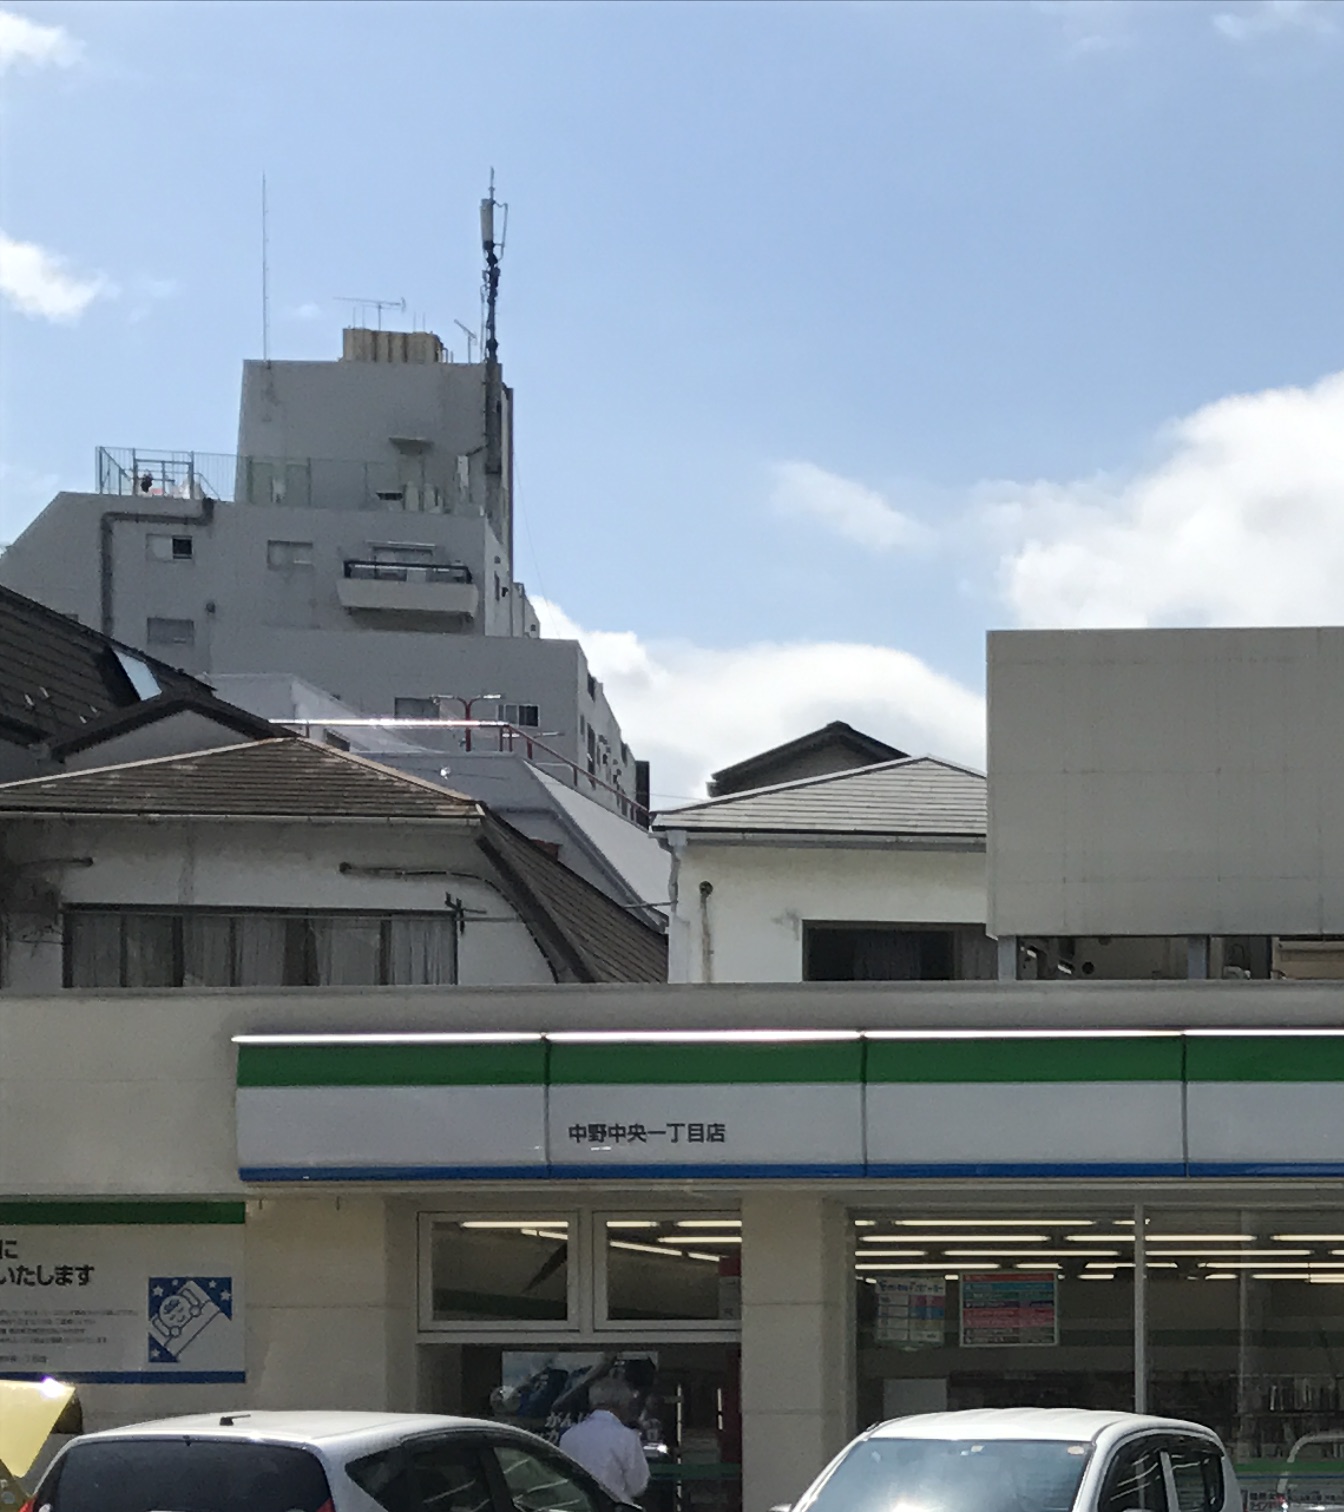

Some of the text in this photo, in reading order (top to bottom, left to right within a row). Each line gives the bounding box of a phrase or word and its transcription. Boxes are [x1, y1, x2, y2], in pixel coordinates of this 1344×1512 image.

[568, 1123, 725, 1143] 中野中央一丁目店
